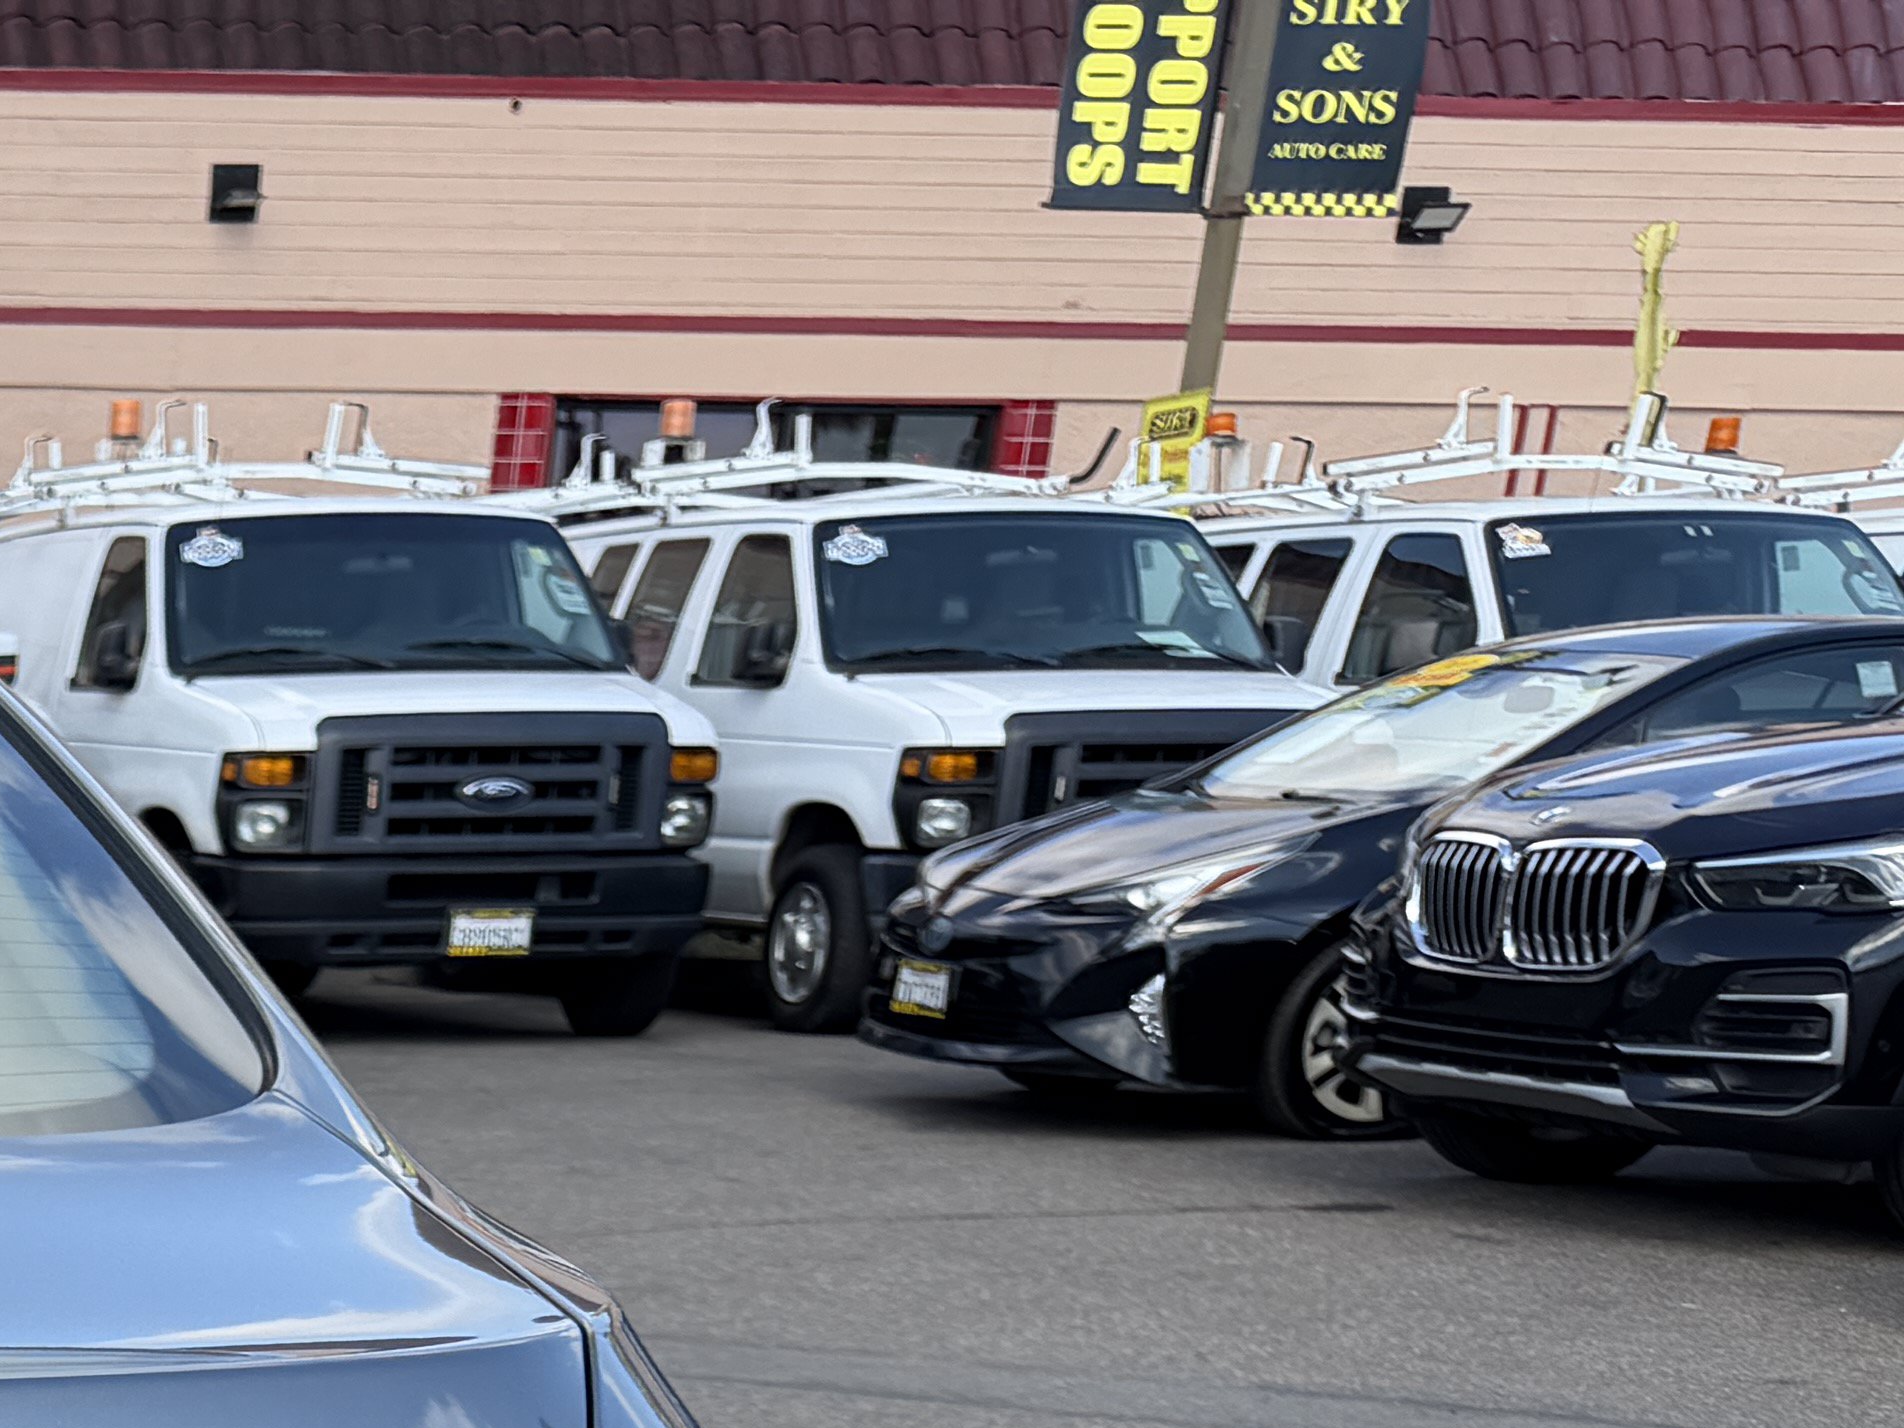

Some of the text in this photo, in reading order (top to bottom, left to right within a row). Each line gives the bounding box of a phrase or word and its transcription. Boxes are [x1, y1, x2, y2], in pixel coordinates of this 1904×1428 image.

[1321, 41, 1365, 72] &
[1272, 88, 1399, 125] SONS
[1267, 141, 1388, 161] AUTO CARE
